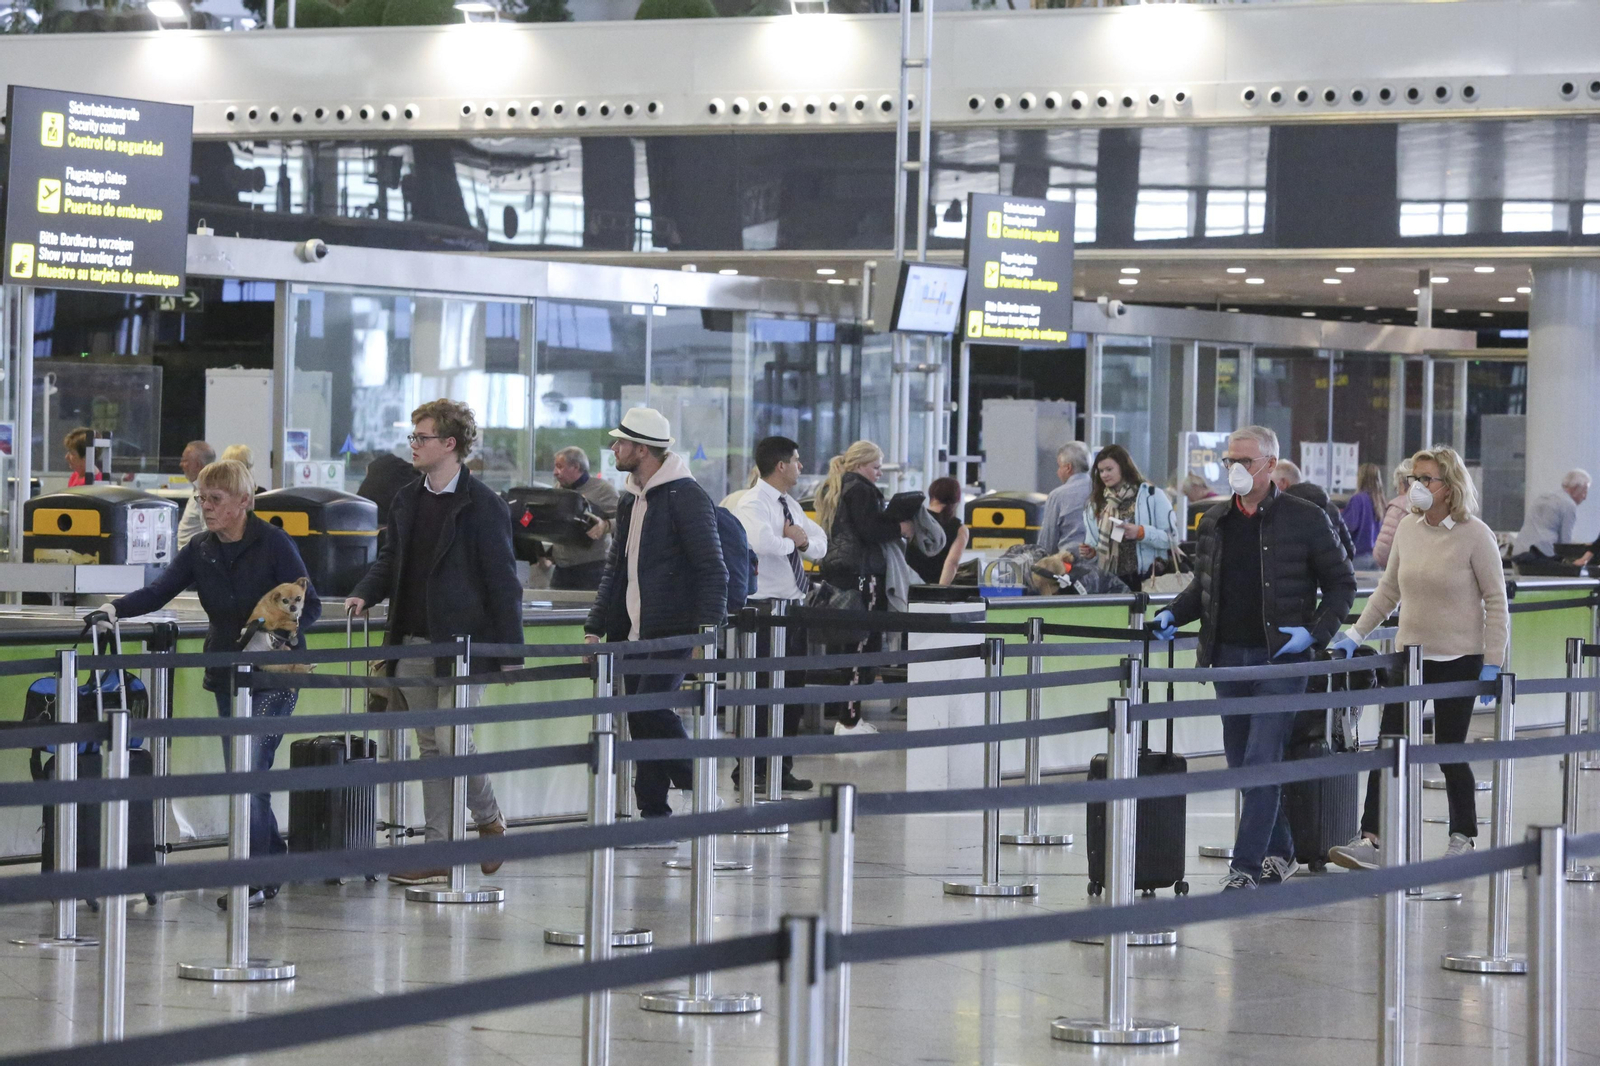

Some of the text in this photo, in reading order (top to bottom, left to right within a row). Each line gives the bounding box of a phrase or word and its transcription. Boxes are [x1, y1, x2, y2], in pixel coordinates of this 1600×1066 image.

[68, 117, 125, 135] Security control
[68, 132, 163, 156] Control de seguridad
[66, 166, 126, 185] Flugsteige Gates
[65, 183, 120, 201] Boarding gates
[64, 199, 162, 223] Puertas de embarque
[40, 231, 133, 252] Bitte Bordkarte vorzeigen
[39, 247, 132, 267] Show your boarding card
[37, 264, 179, 288] Muestre su tarjeta de embarque
[653, 283, 659, 304] 3
